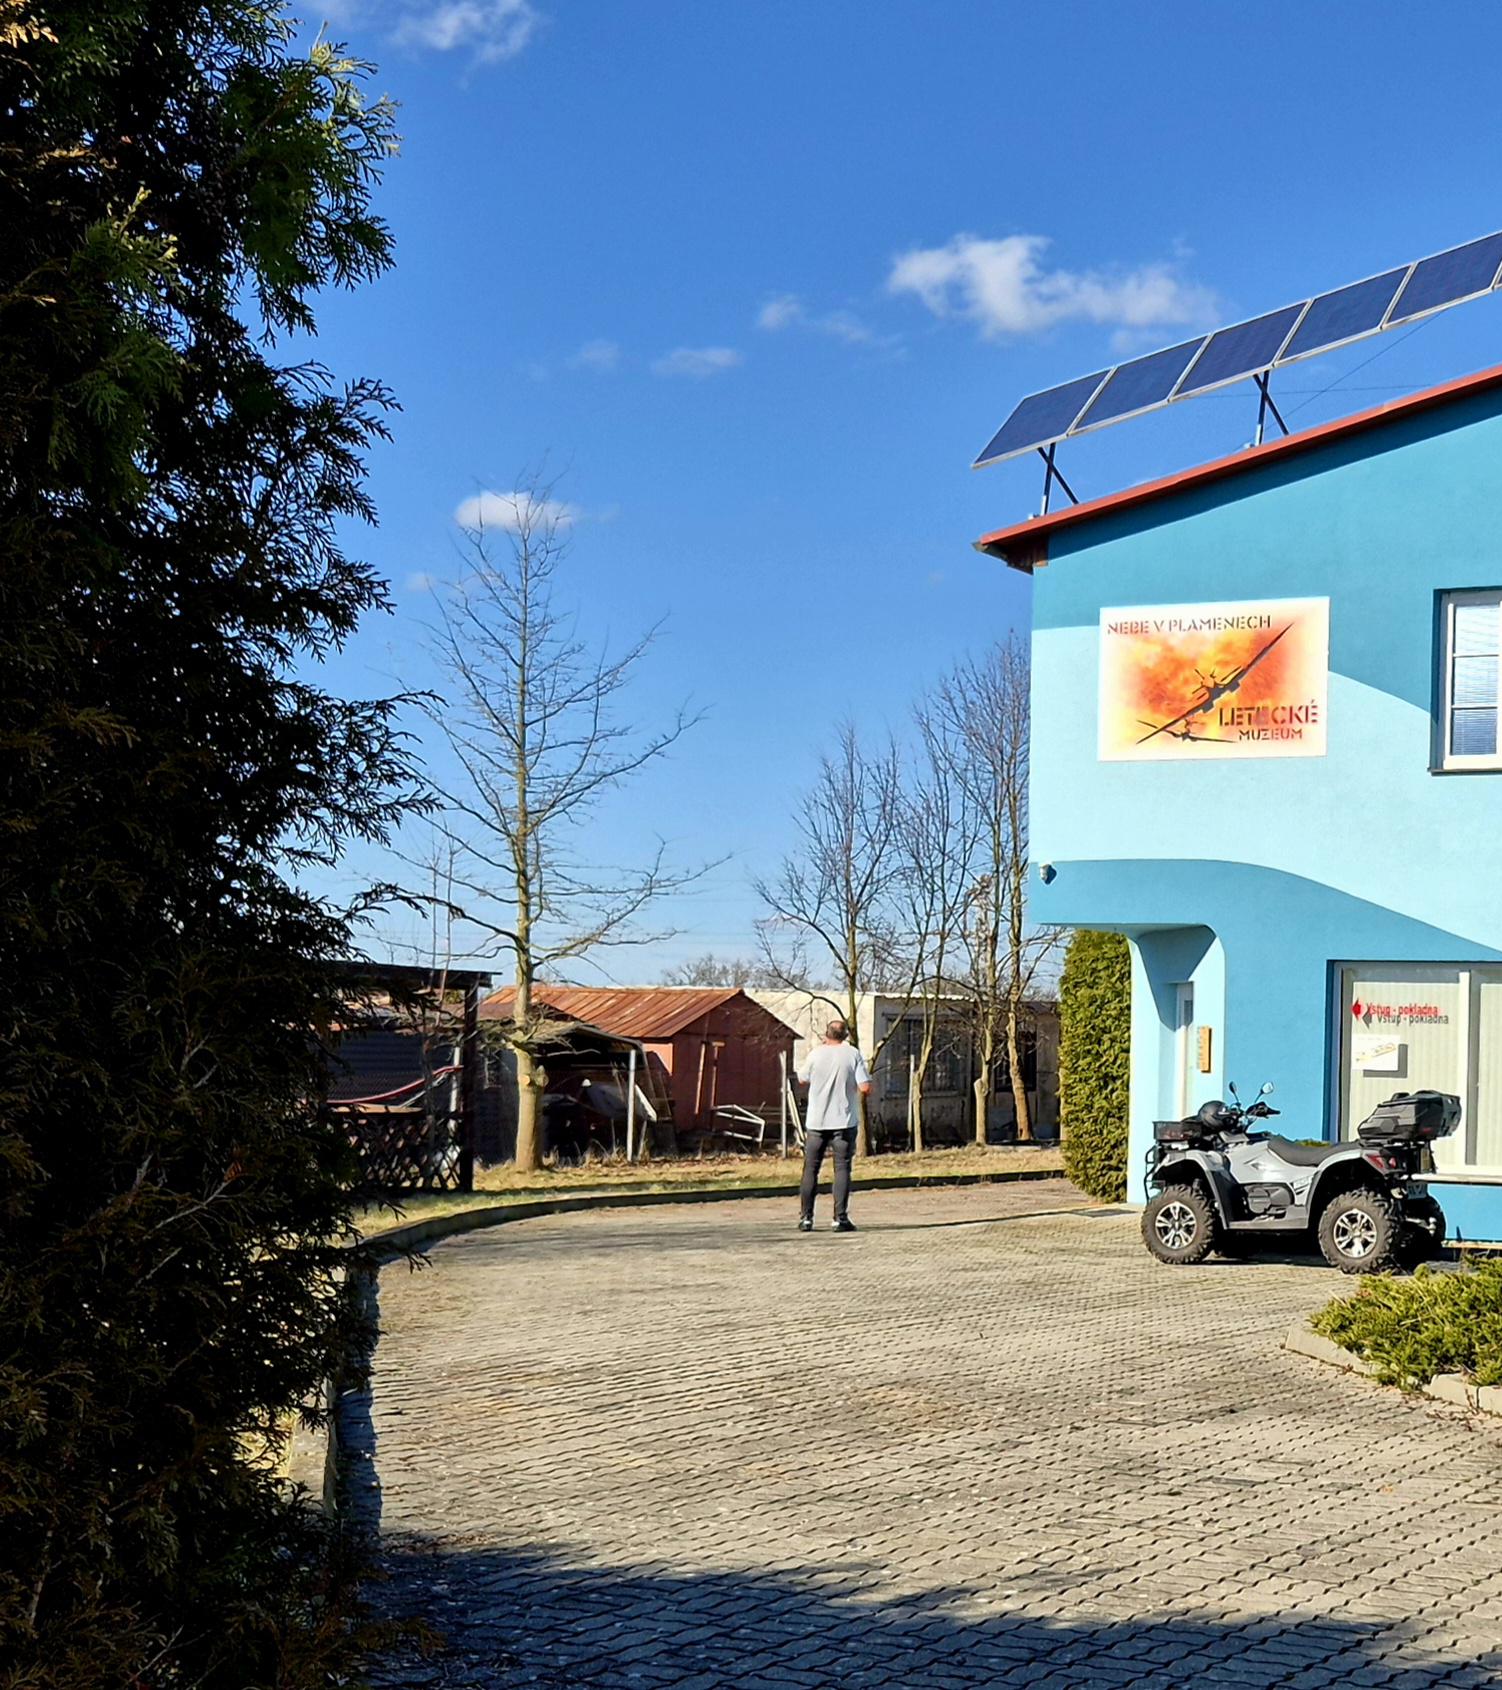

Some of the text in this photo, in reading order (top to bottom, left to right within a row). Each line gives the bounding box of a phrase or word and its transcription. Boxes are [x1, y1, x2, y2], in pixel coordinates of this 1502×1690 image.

[1107, 615, 1271, 635] NEBE V PLAMENECH
[1238, 728, 1303, 741] MUZEUM
